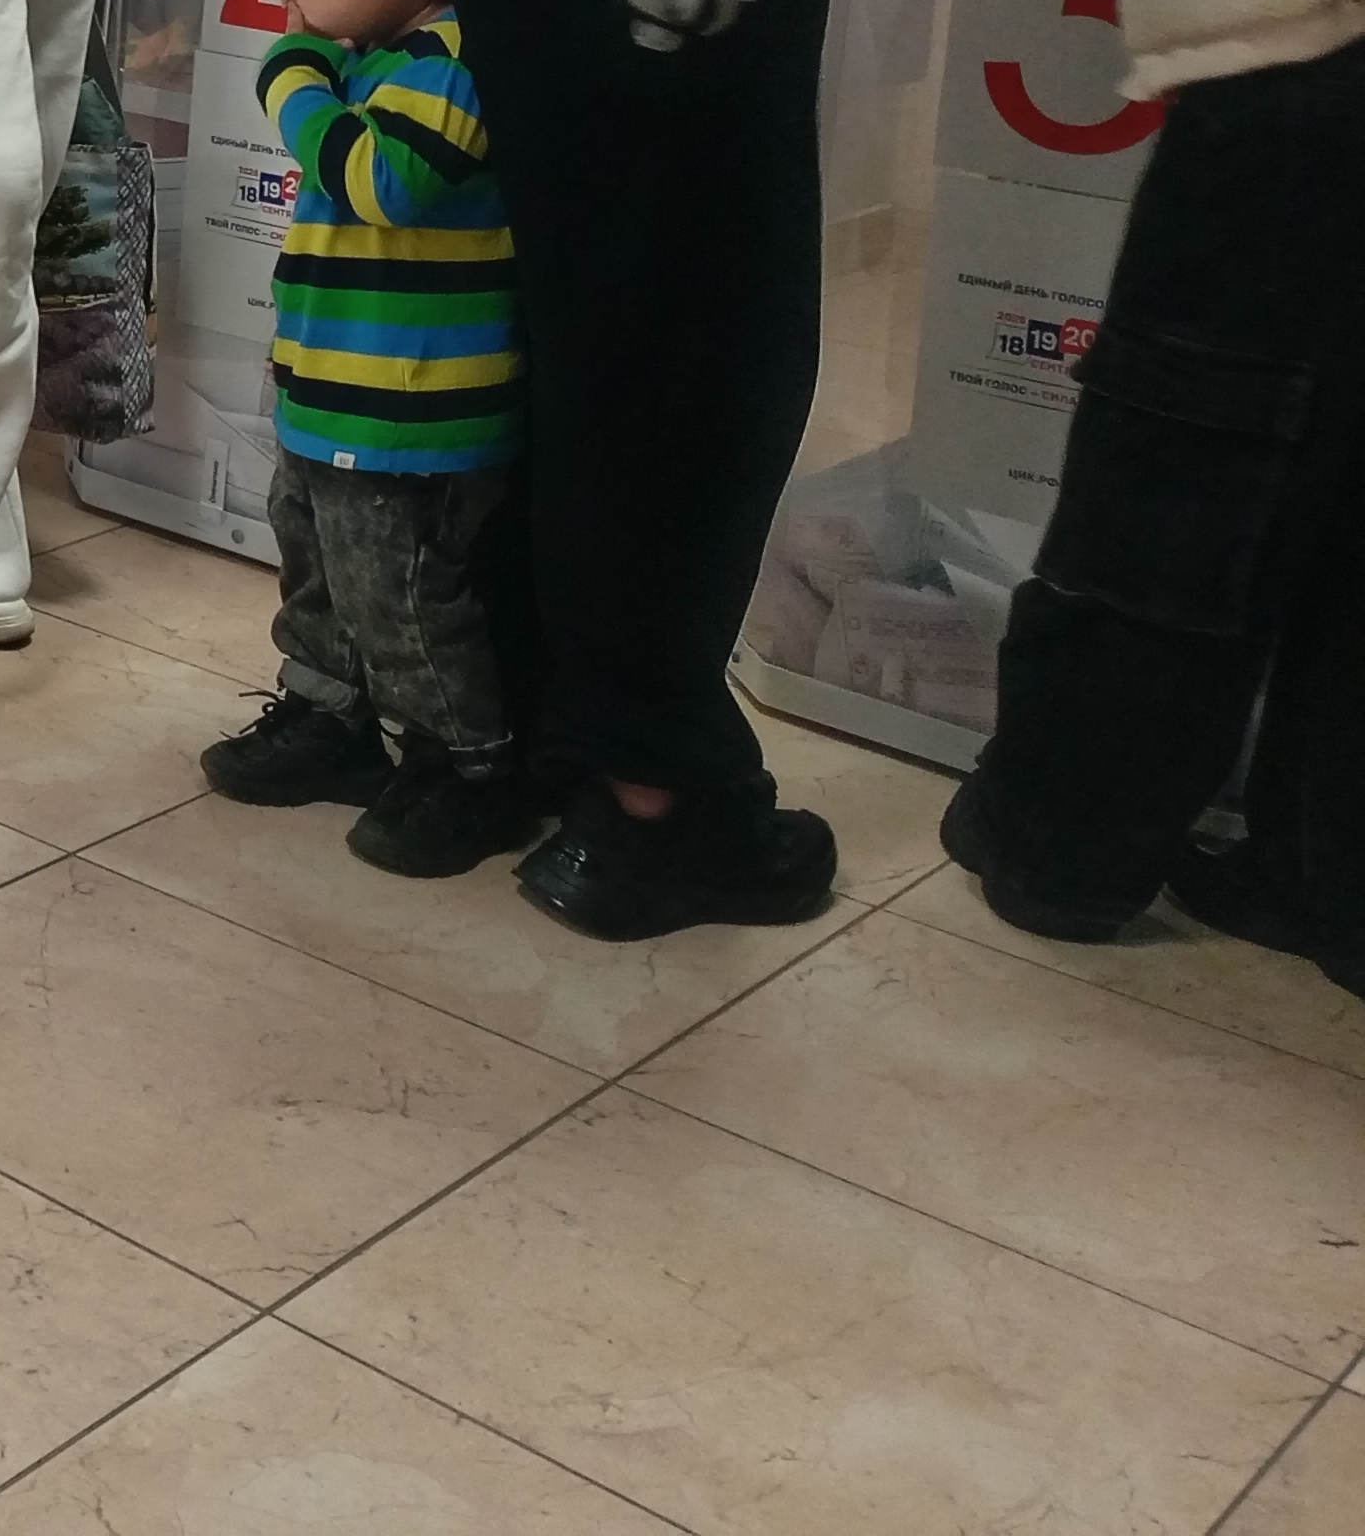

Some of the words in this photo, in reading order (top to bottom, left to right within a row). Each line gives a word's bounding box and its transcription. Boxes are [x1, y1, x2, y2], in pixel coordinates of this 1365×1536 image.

[239, 185, 258, 203] 18
[262, 181, 280, 199] 19
[285, 177, 300, 195] 2
[261, 205, 292, 218] СЕНТЯ
[958, 273, 1012, 291] ЕДИНЫЙ
[1013, 284, 1049, 299] ДЕНЬ
[1052, 291, 1105, 309] ГОЛОСО
[999, 334, 1025, 356] 18
[1030, 329, 1058, 351] 19
[1063, 326, 1096, 349] 20
[949, 370, 983, 387] ТВОЙ
[985, 378, 1028, 395] ГОЛОС
